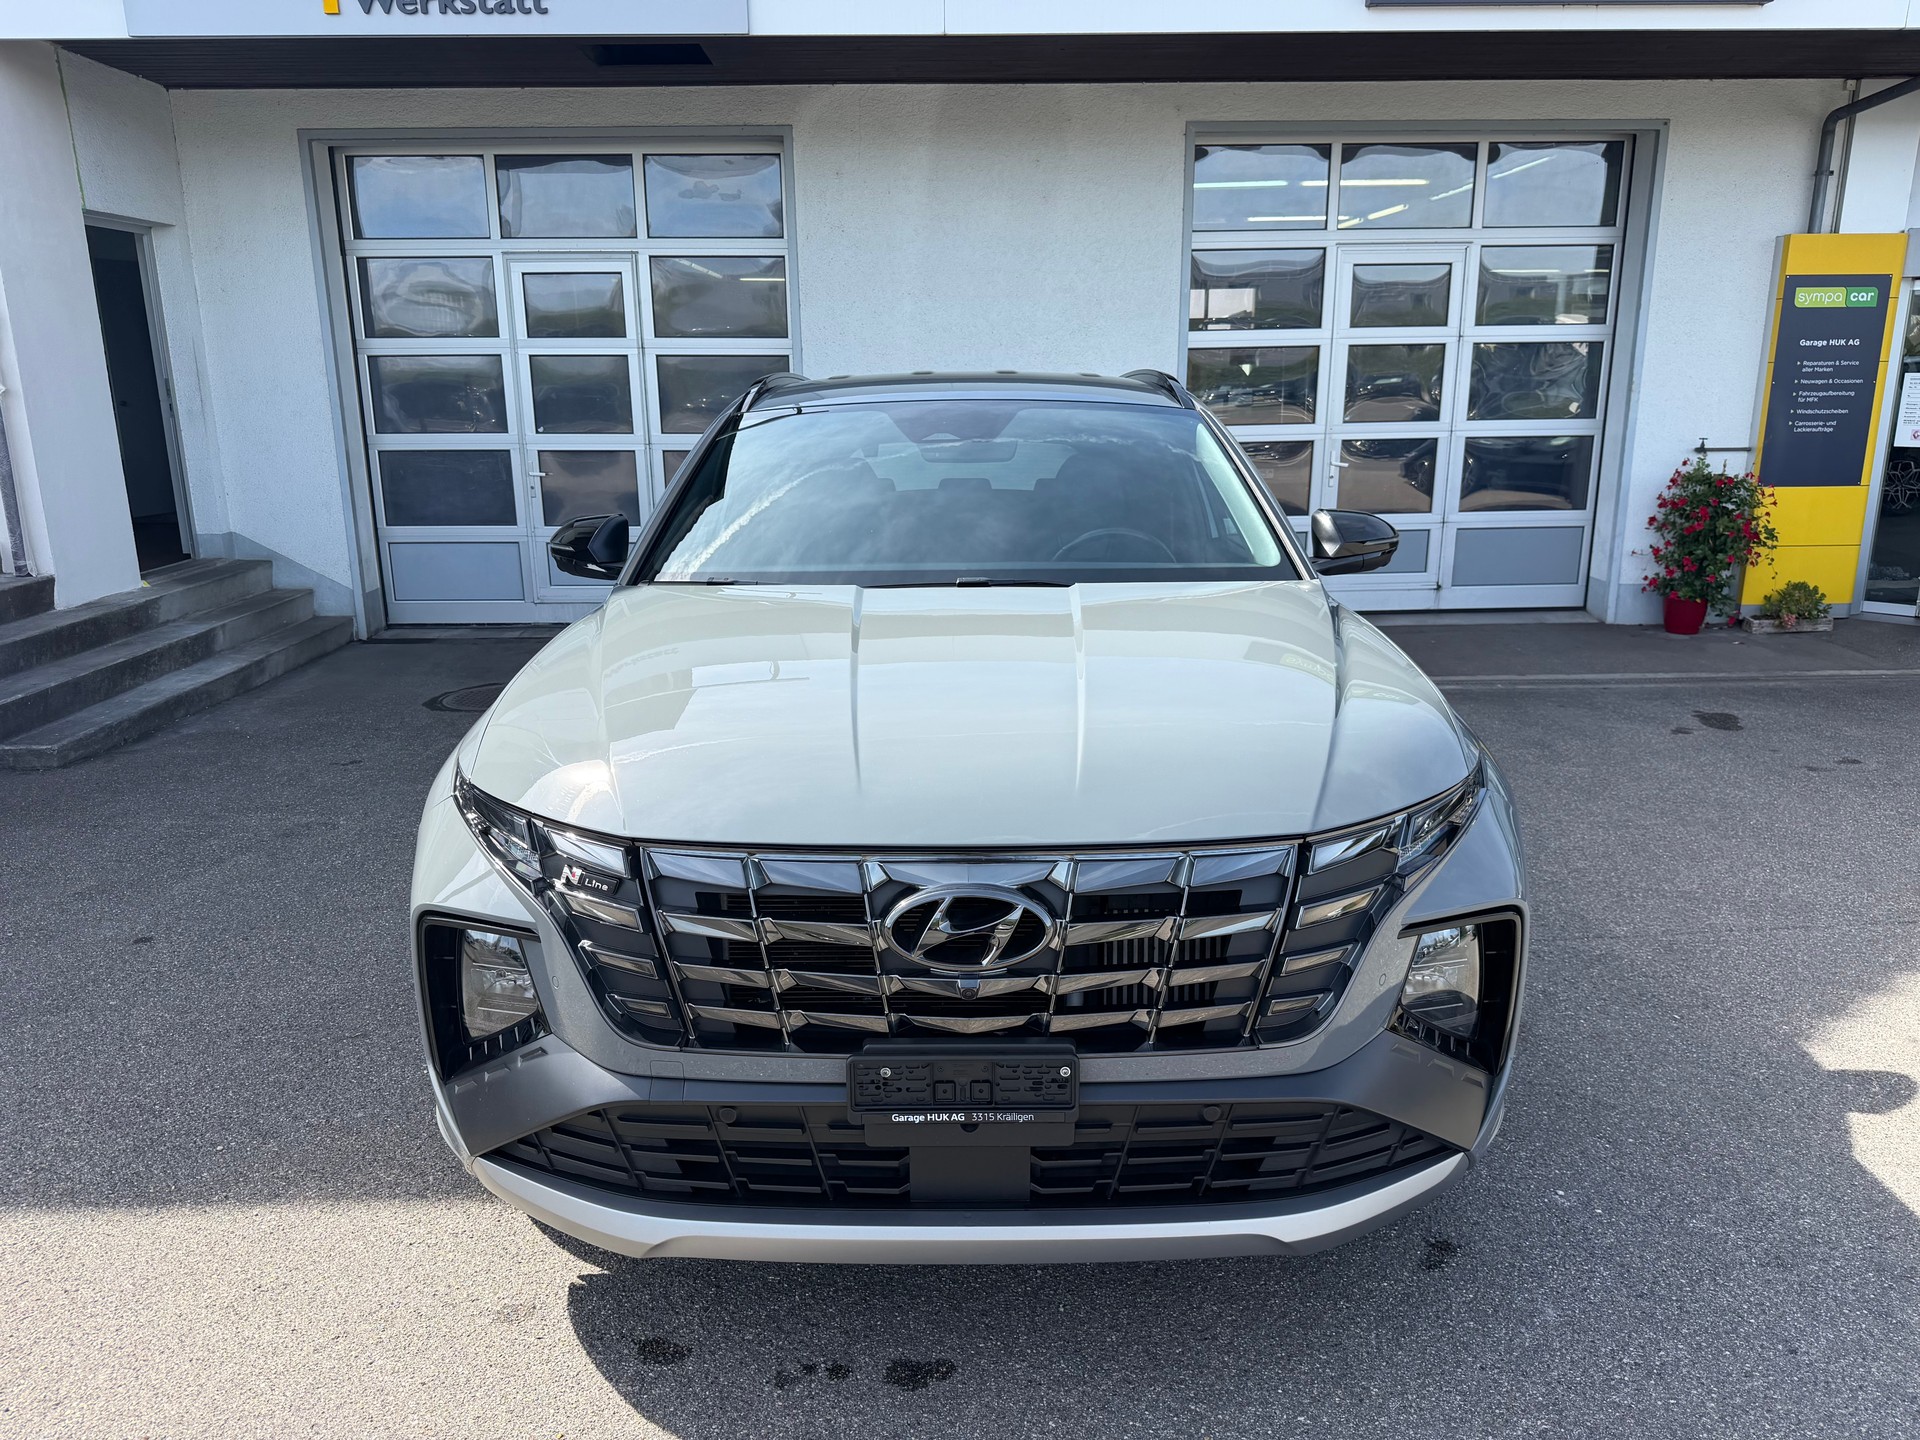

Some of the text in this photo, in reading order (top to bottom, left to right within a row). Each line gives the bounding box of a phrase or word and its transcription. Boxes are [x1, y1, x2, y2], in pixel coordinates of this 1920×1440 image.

[1798, 292, 1875, 305] sympa car
[1799, 339, 1828, 347] Garage
[560, 864, 609, 892] N Line
[891, 1113, 926, 1124] Garage
[926, 1113, 950, 1122] HUK
[950, 1113, 965, 1121] AG
[971, 1112, 995, 1121] 3315
